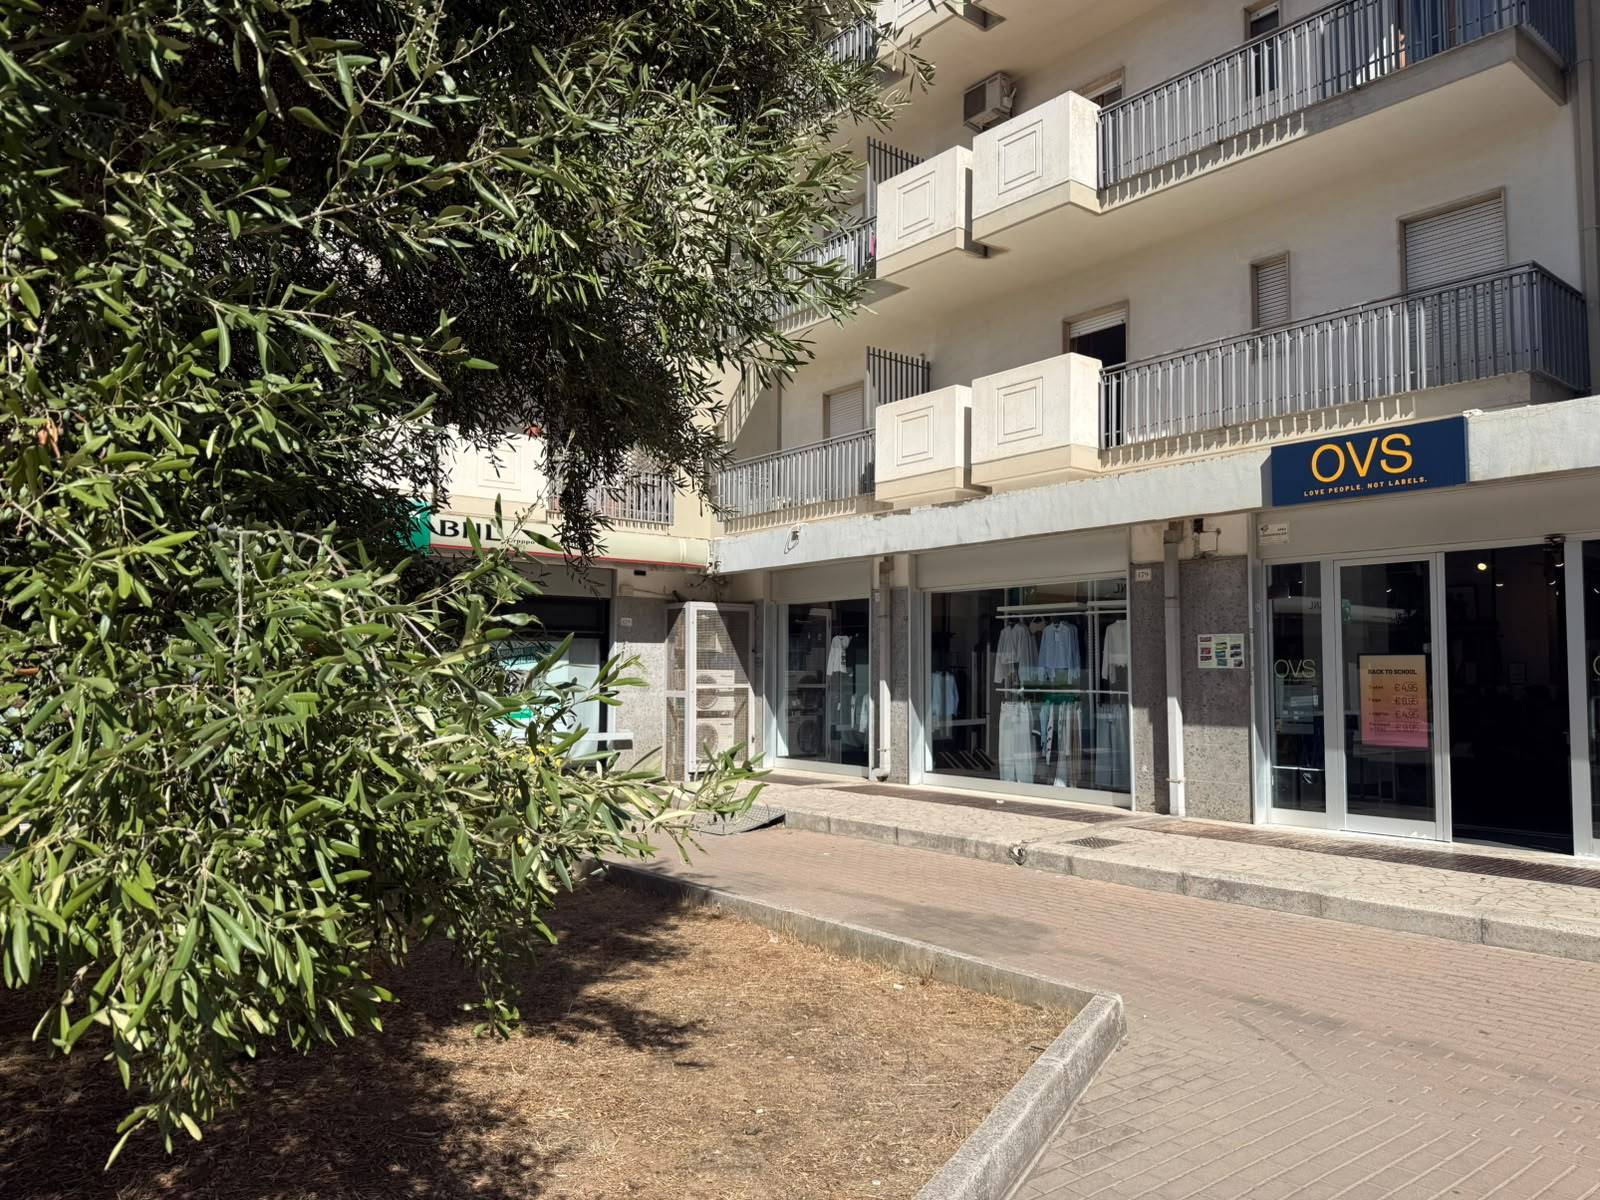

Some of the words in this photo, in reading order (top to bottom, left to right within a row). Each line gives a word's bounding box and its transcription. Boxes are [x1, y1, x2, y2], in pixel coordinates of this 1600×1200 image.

[1311, 433, 1413, 482] OVS
[1303, 489, 1325, 497] LOVE
[1328, 484, 1363, 493] PEOPLE.
[1367, 481, 1384, 489] NOT
[1388, 477, 1428, 486] LABELS.
[1274, 659, 1316, 678] OVS
